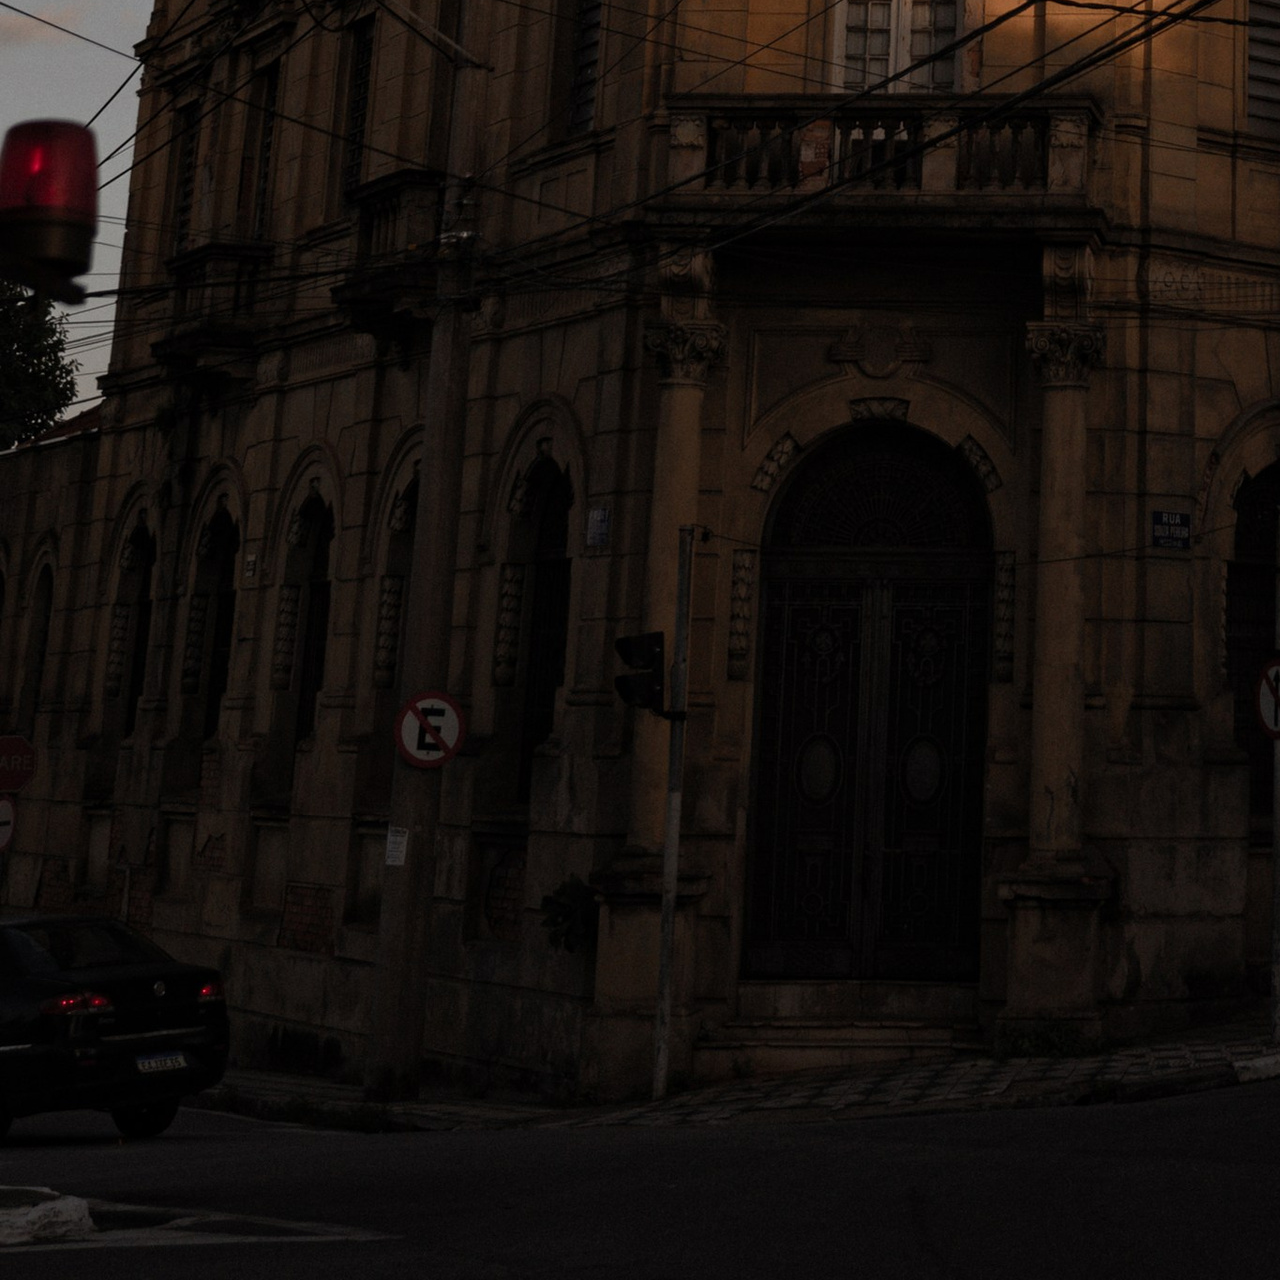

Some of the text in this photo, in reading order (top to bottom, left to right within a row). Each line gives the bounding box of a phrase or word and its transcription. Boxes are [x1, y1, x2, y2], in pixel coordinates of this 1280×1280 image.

[1162, 512, 1182, 525] RUA
[417, 707, 446, 751] E
[0, 754, 33, 771] ARE
